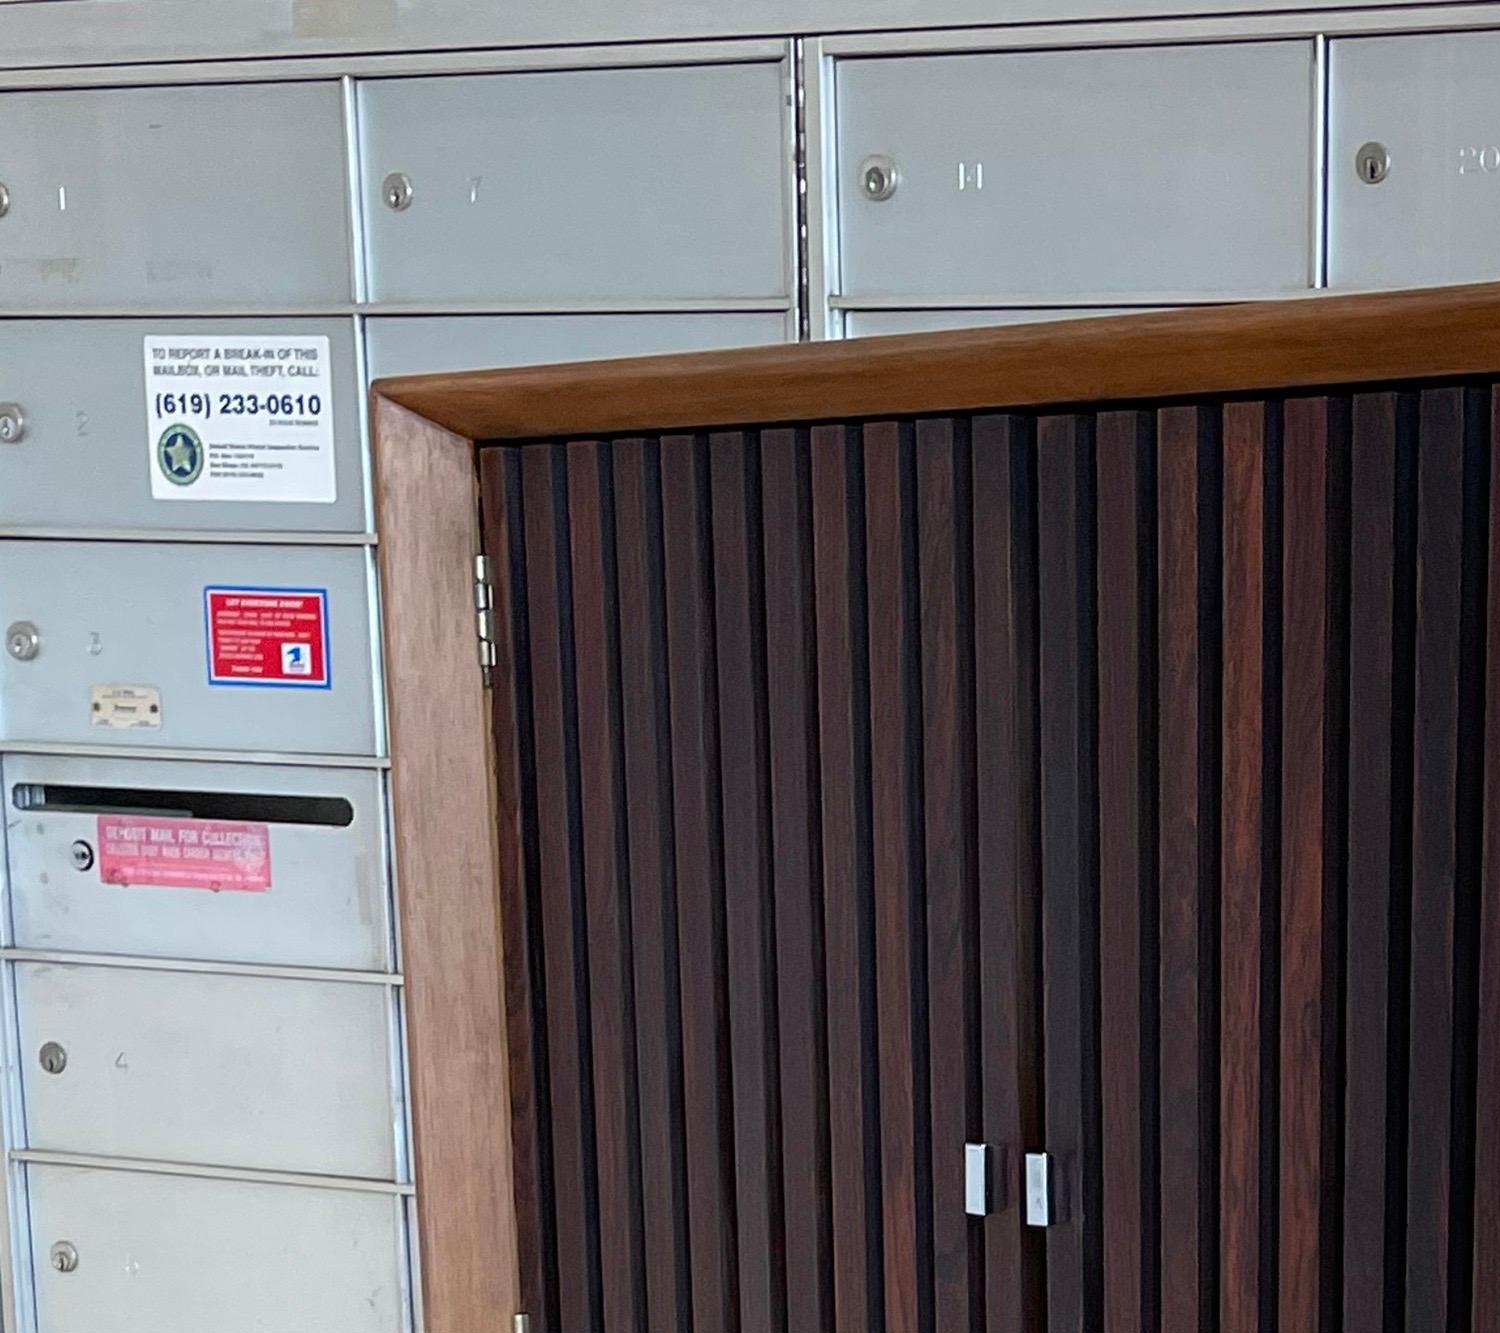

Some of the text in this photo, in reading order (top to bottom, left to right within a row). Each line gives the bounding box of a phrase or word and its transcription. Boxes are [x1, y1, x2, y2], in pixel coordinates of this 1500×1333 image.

[1459, 146, 1500, 174] 20
[152, 348, 166, 360] TO
[168, 348, 210, 360] REPORT
[214, 348, 221, 360] A
[277, 348, 292, 360] OF
[293, 348, 318, 361] THIS
[204, 365, 221, 377] OR
[222, 365, 249, 377] MAIL
[156, 393, 321, 419] (619) 233-0610
[114, 1051, 129, 1075] 4
